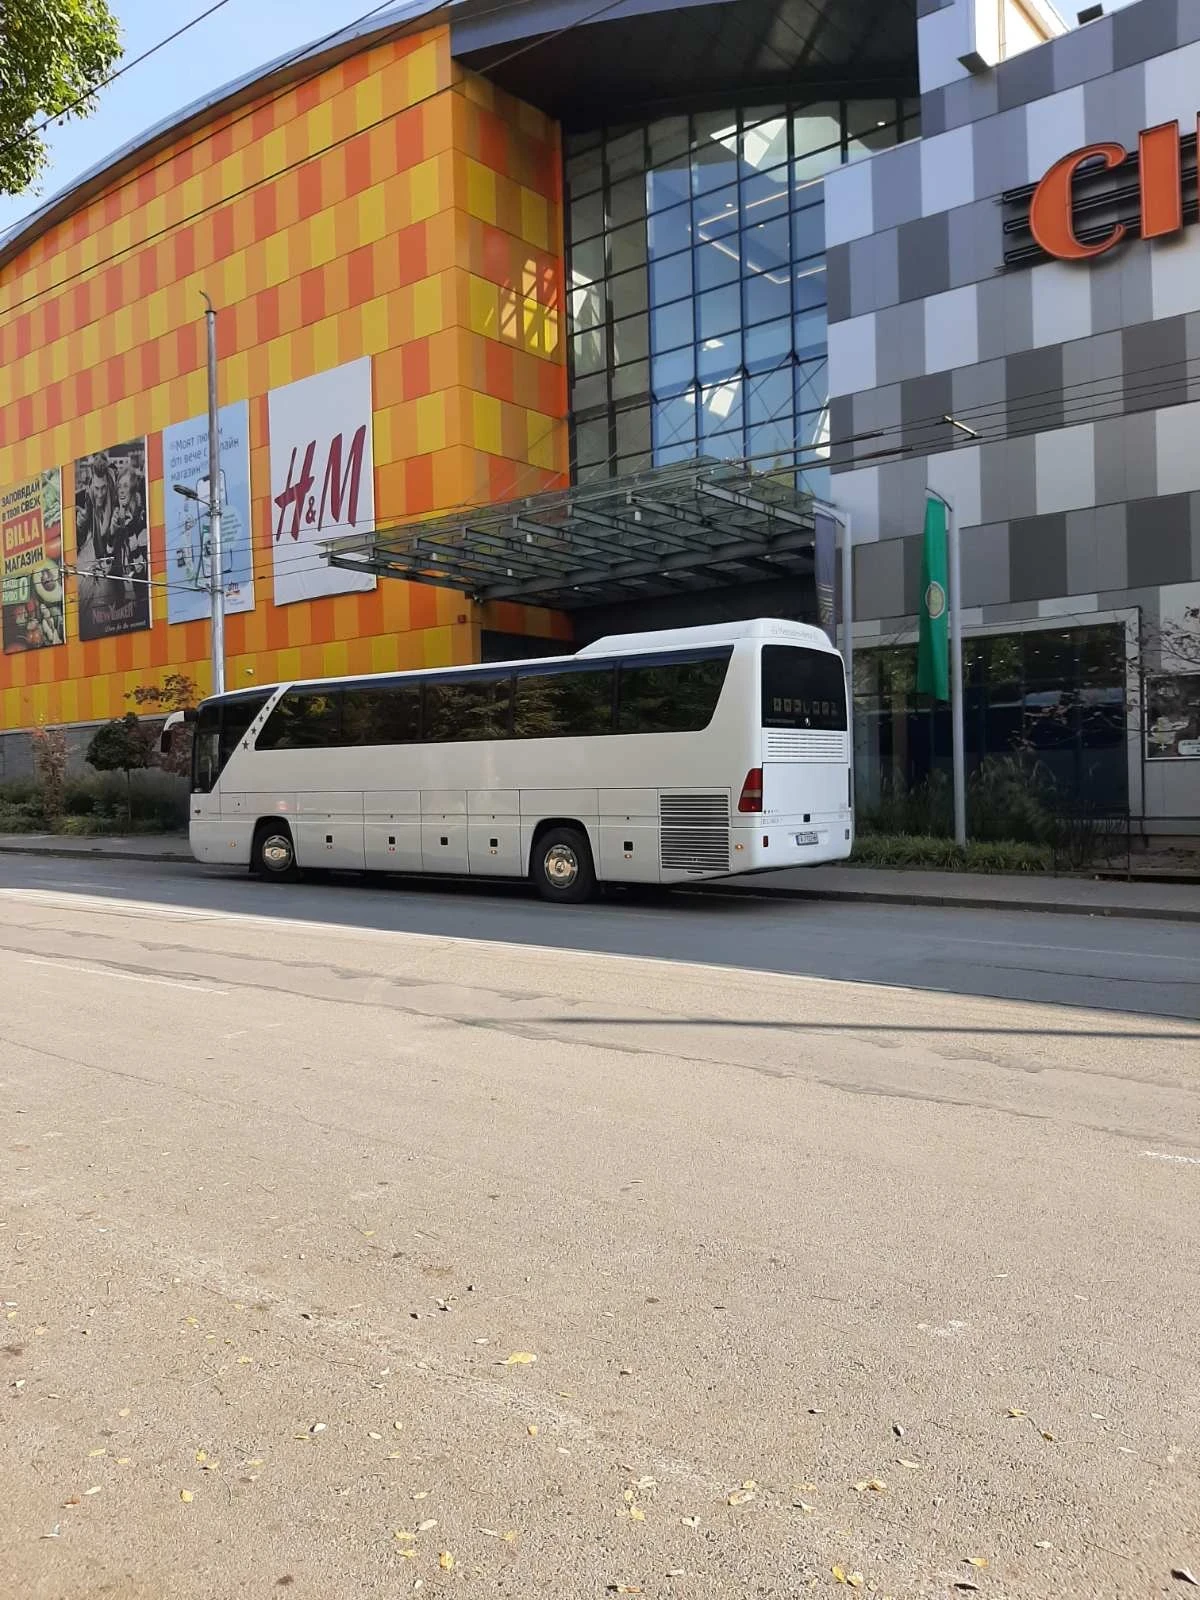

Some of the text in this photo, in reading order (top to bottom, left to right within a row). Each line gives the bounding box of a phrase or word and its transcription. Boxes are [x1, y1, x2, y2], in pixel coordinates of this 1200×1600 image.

[171, 465, 201, 482] магазин
[273, 424, 366, 542] H&M
[5, 518, 41, 551] BILLA
[4, 546, 44, 574] МАГАЗИН
